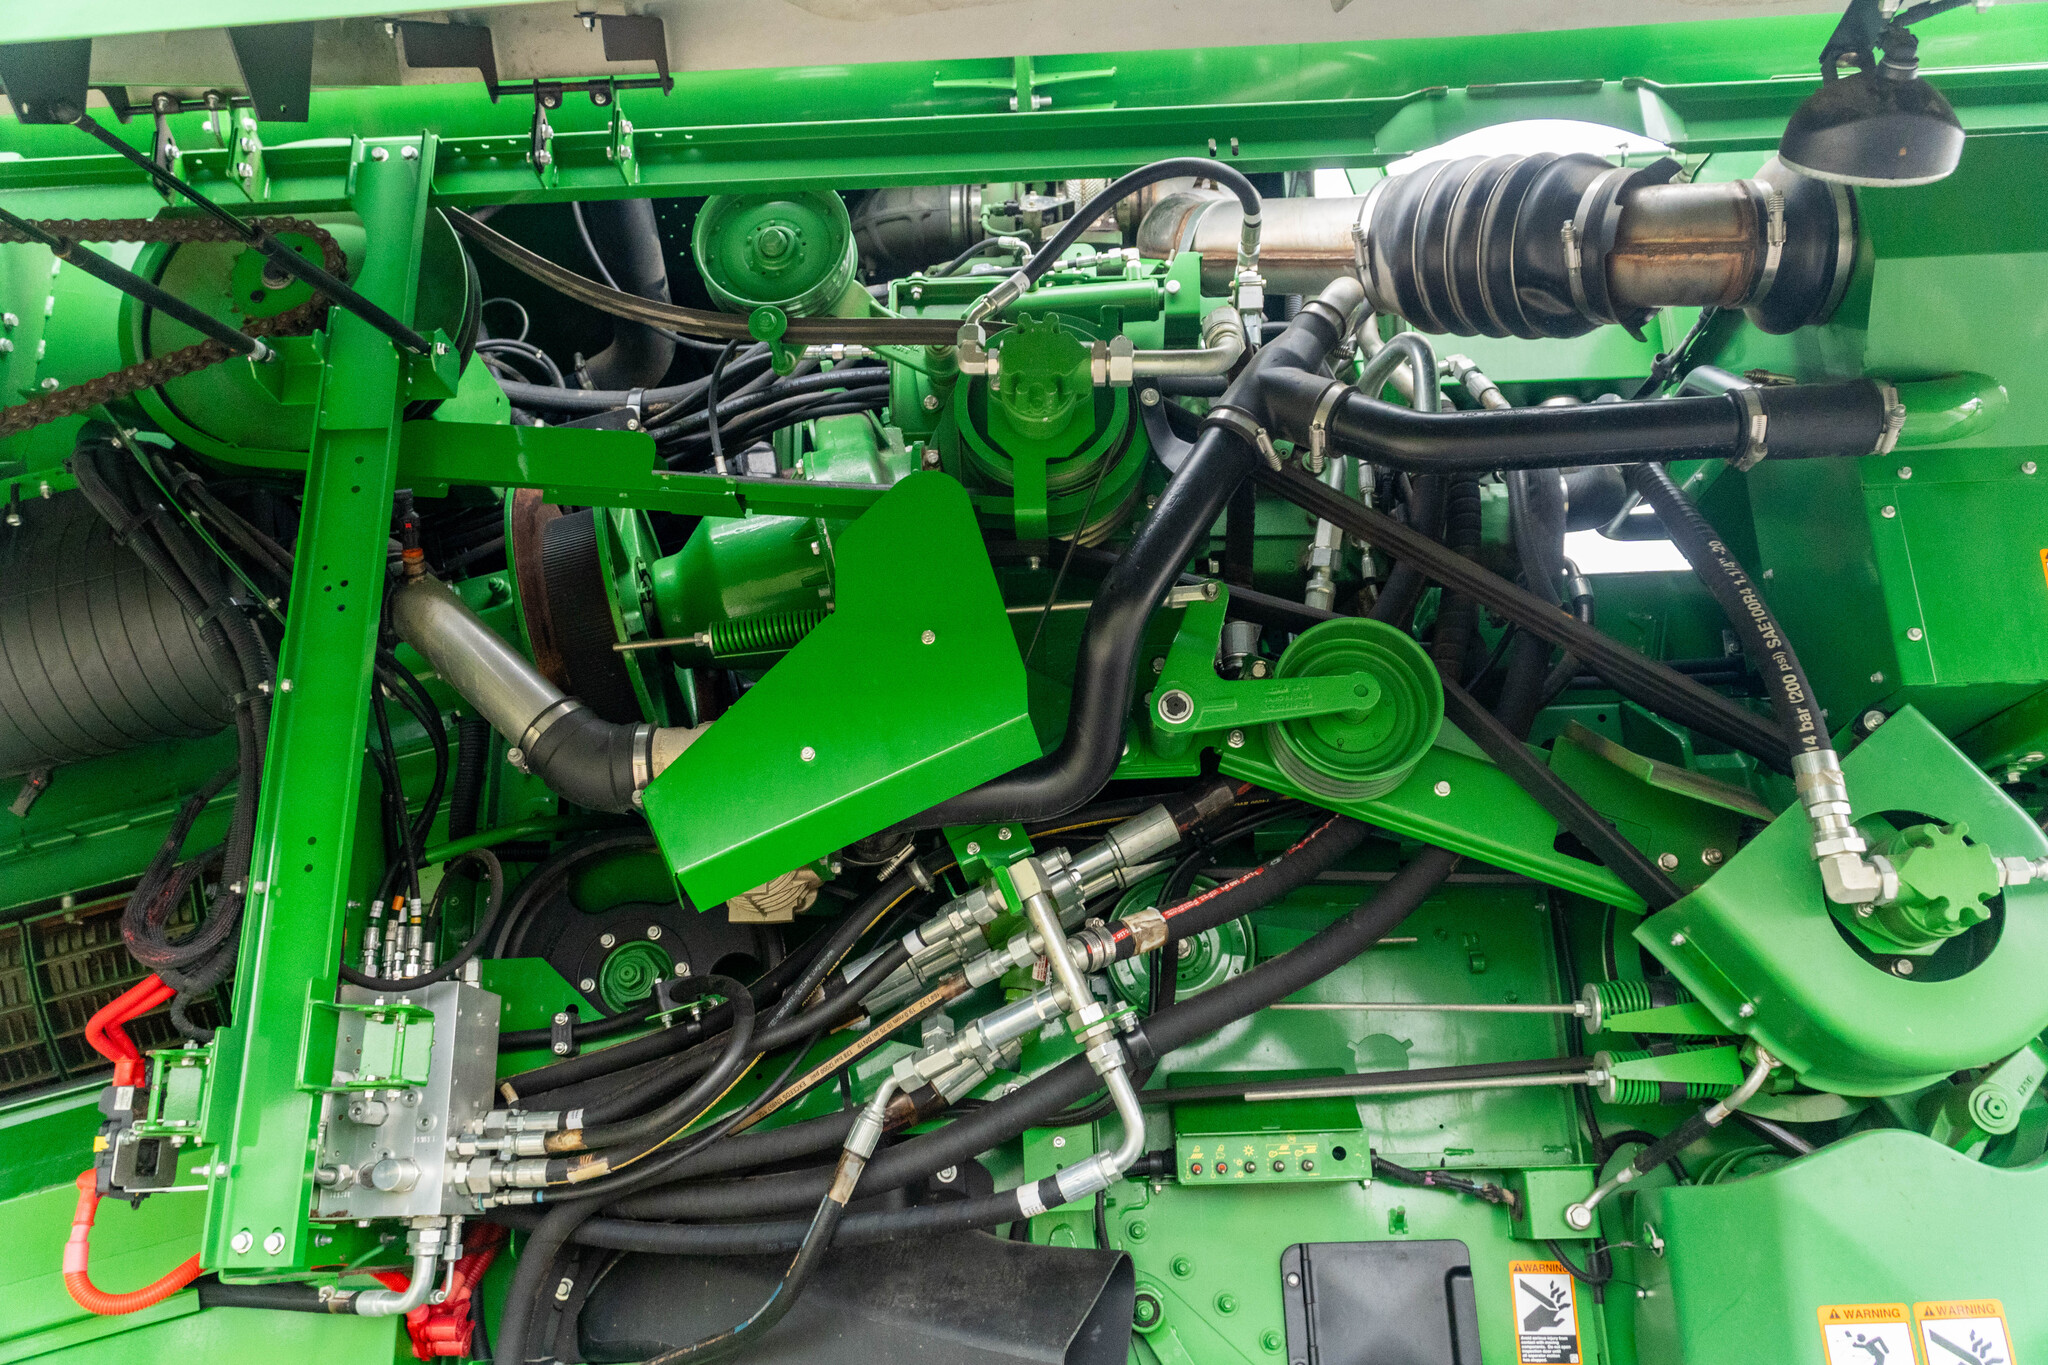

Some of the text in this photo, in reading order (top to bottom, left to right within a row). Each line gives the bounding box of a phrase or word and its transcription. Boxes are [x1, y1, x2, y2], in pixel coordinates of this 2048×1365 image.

[1739, 587, 1782, 649] SAE100R4
[1772, 651, 1793, 671] psi)
[1782, 674, 1805, 704] (200
[1796, 707, 1815, 732] bar
[782, 1081, 807, 1099] EXCEEDS
[1843, 1308, 1901, 1320] WARNING
[1935, 1303, 1996, 1316] WARNING
